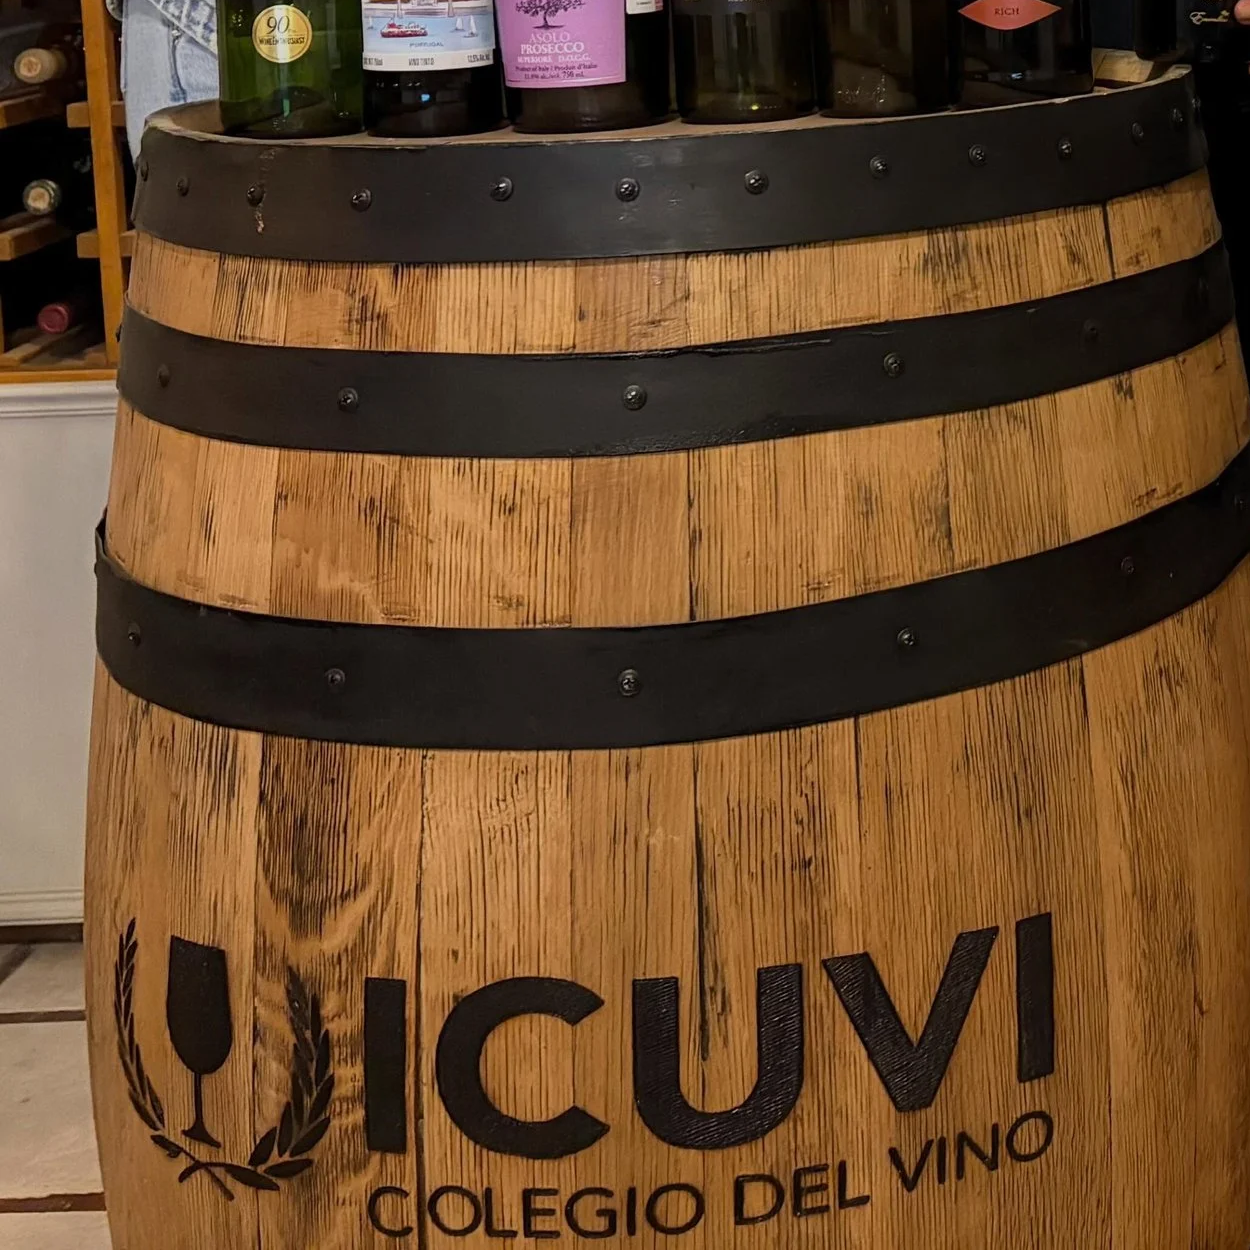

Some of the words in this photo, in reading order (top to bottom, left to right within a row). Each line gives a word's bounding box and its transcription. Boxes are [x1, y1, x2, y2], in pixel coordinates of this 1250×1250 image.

[994, 8, 1020, 16] RICH
[266, 15, 290, 35] 90
[529, 31, 571, 44] ASOLO
[520, 41, 585, 55] PROSECCO
[364, 911, 1054, 1161] ICUVI
[367, 1184, 706, 1240] COLEGIO
[733, 1158, 871, 1227] DEL
[888, 1109, 1054, 1194] VINO
